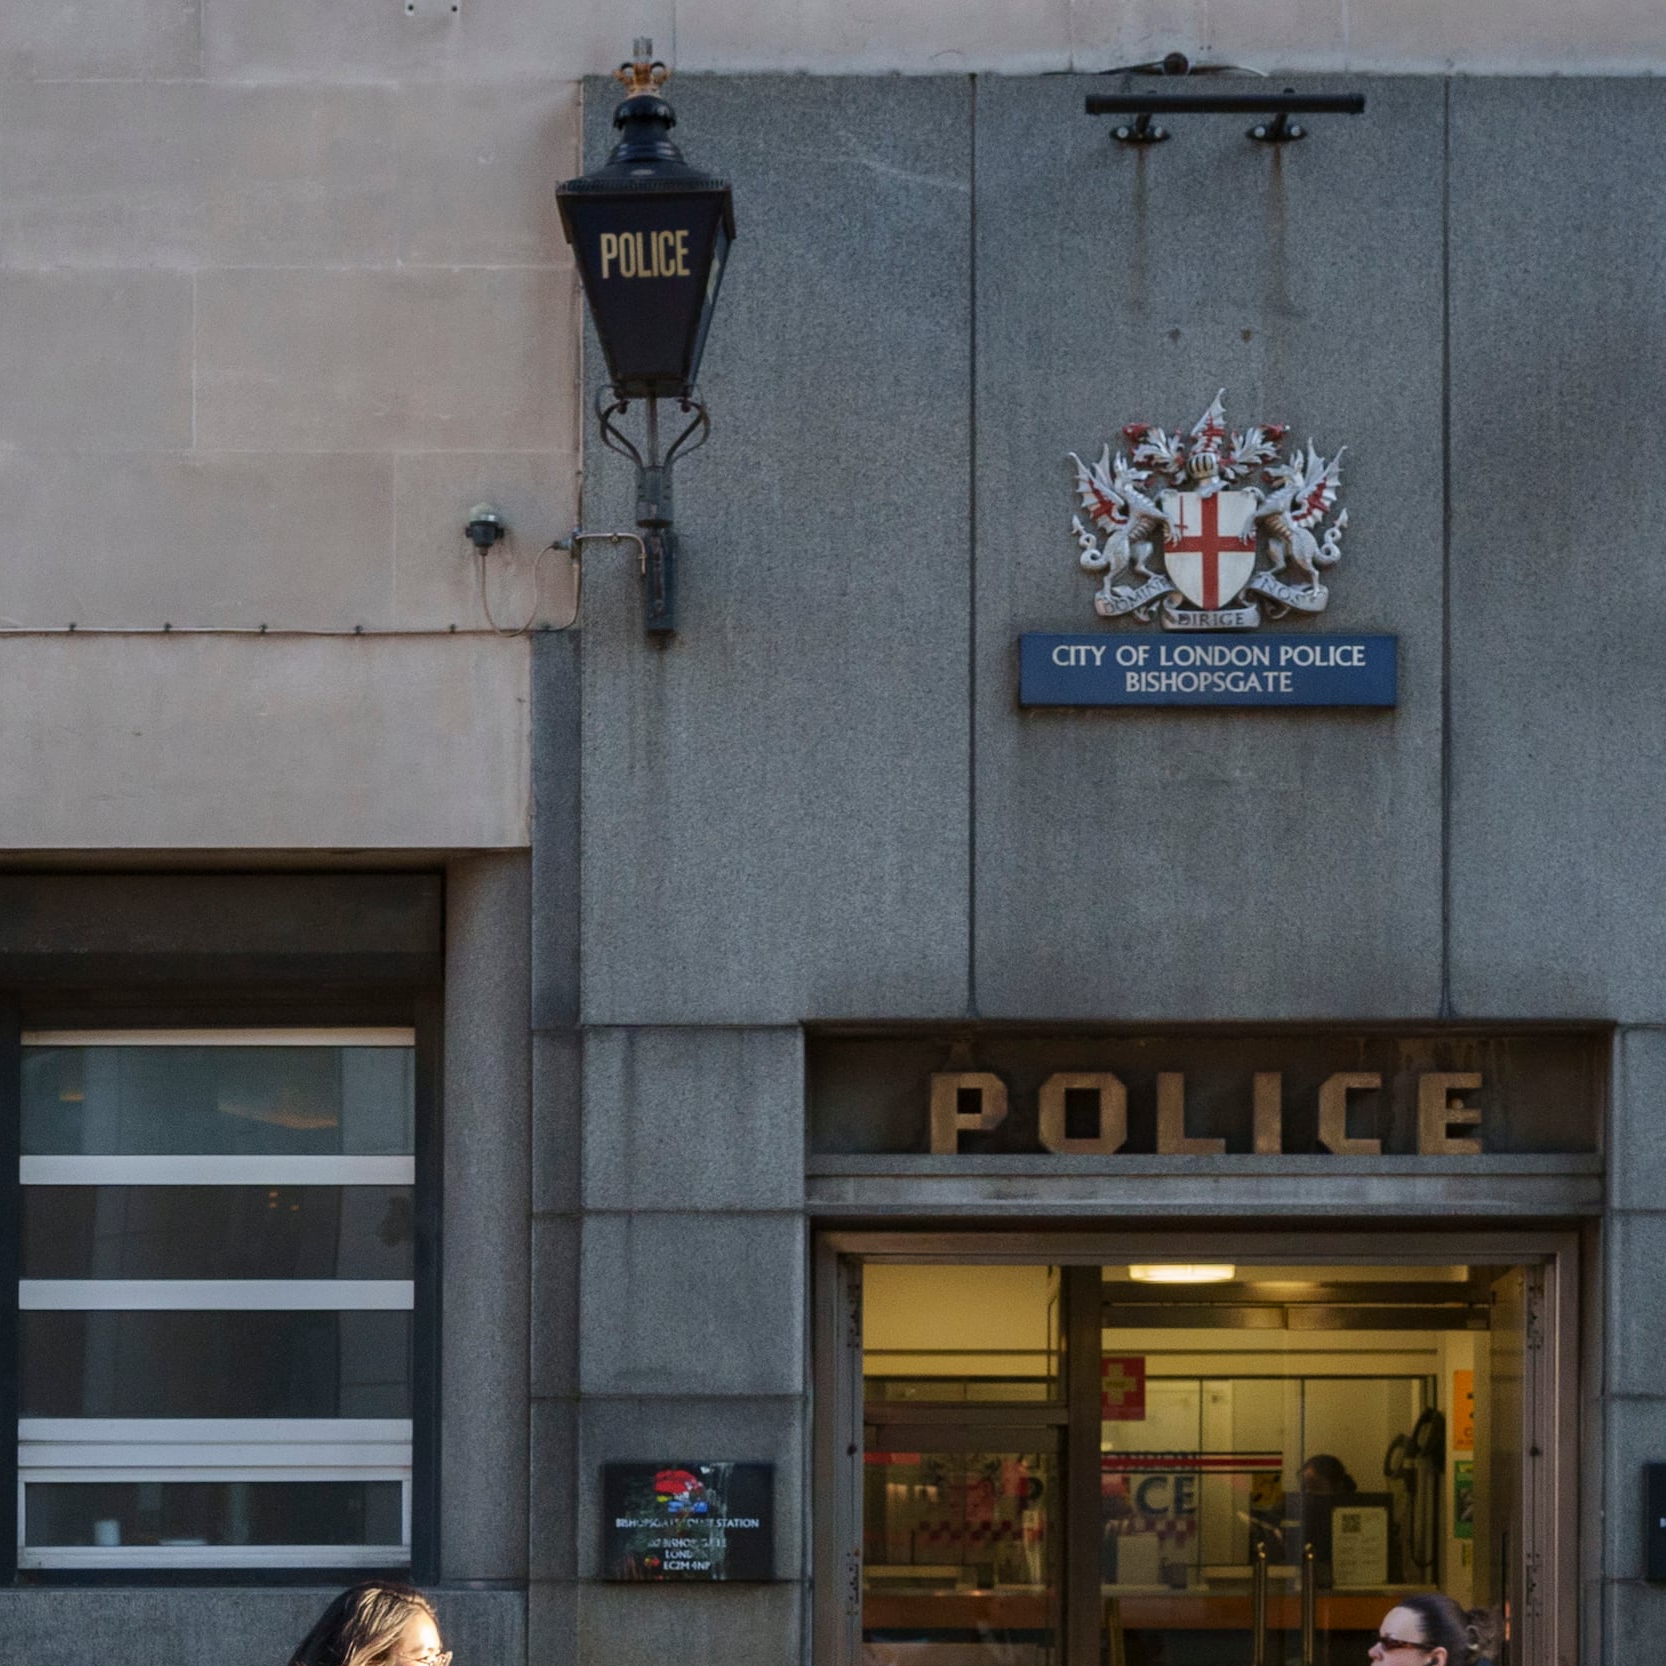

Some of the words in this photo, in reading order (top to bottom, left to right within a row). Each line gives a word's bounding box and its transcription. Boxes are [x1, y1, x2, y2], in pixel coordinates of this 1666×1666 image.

[600, 229, 691, 279] POLICE
[1177, 611, 1246, 627] DIRIGE
[1052, 645, 1106, 667] CITY
[1116, 645, 1150, 667] OF
[1159, 645, 1270, 667] LONDON
[1279, 645, 1366, 667] POLICE
[1125, 671, 1294, 693] BISHOPSGATE
[931, 1071, 1483, 1155] POLICE
[716, 1518, 760, 1528] STATION
[665, 1550, 701, 1559] LOND
